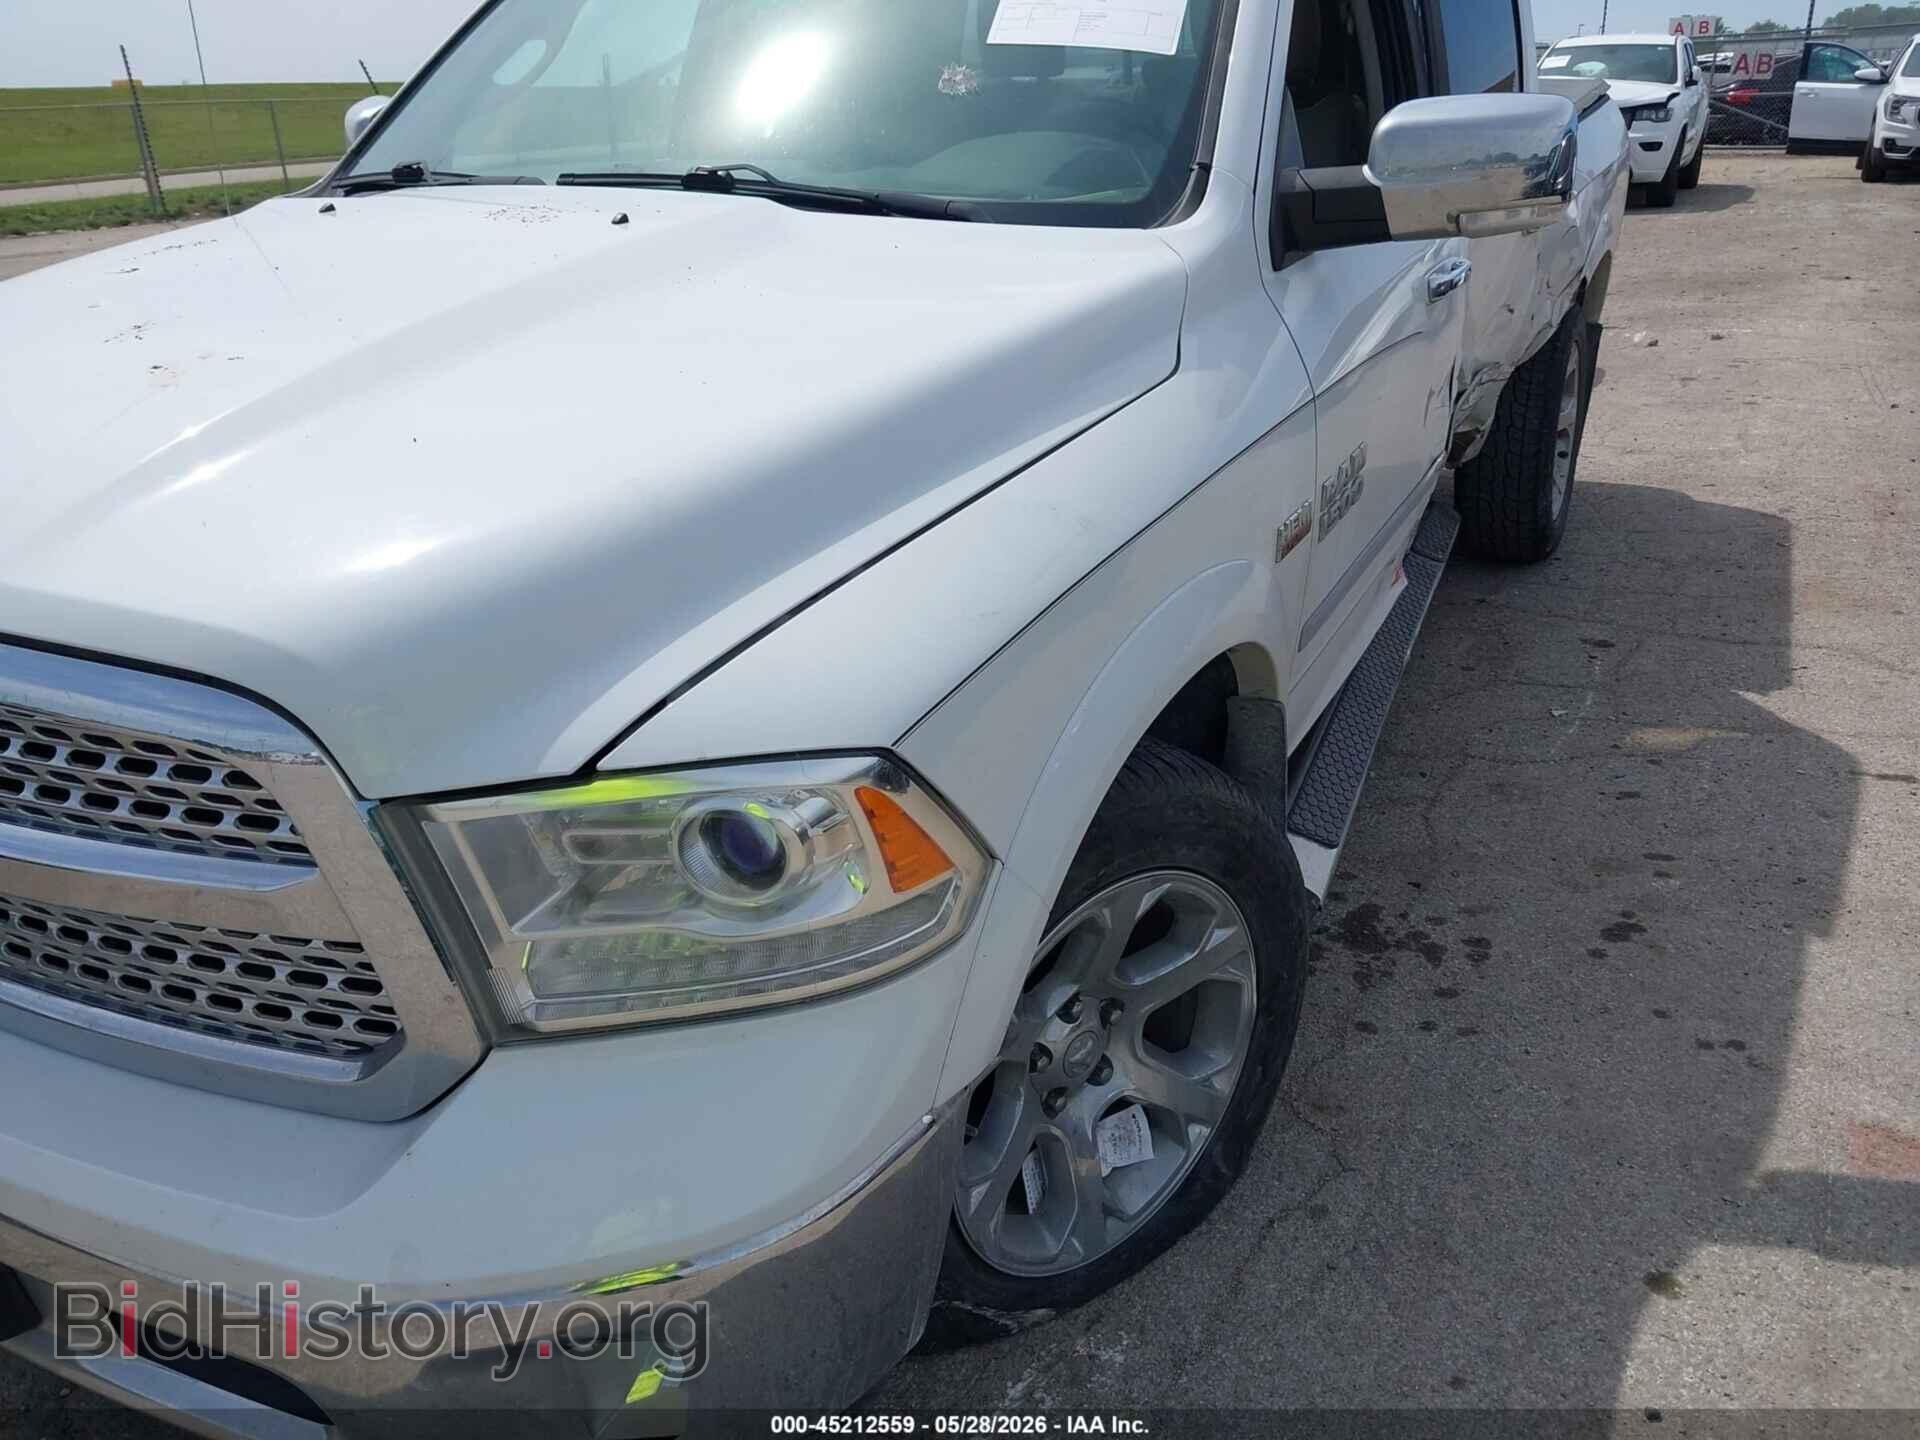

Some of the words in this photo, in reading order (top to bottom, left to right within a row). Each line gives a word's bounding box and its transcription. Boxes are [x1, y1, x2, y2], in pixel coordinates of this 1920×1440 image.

[1674, 21, 1684, 35] A
[1699, 20, 1709, 34] B
[1733, 53, 1749, 74] A
[1756, 53, 1773, 74] B
